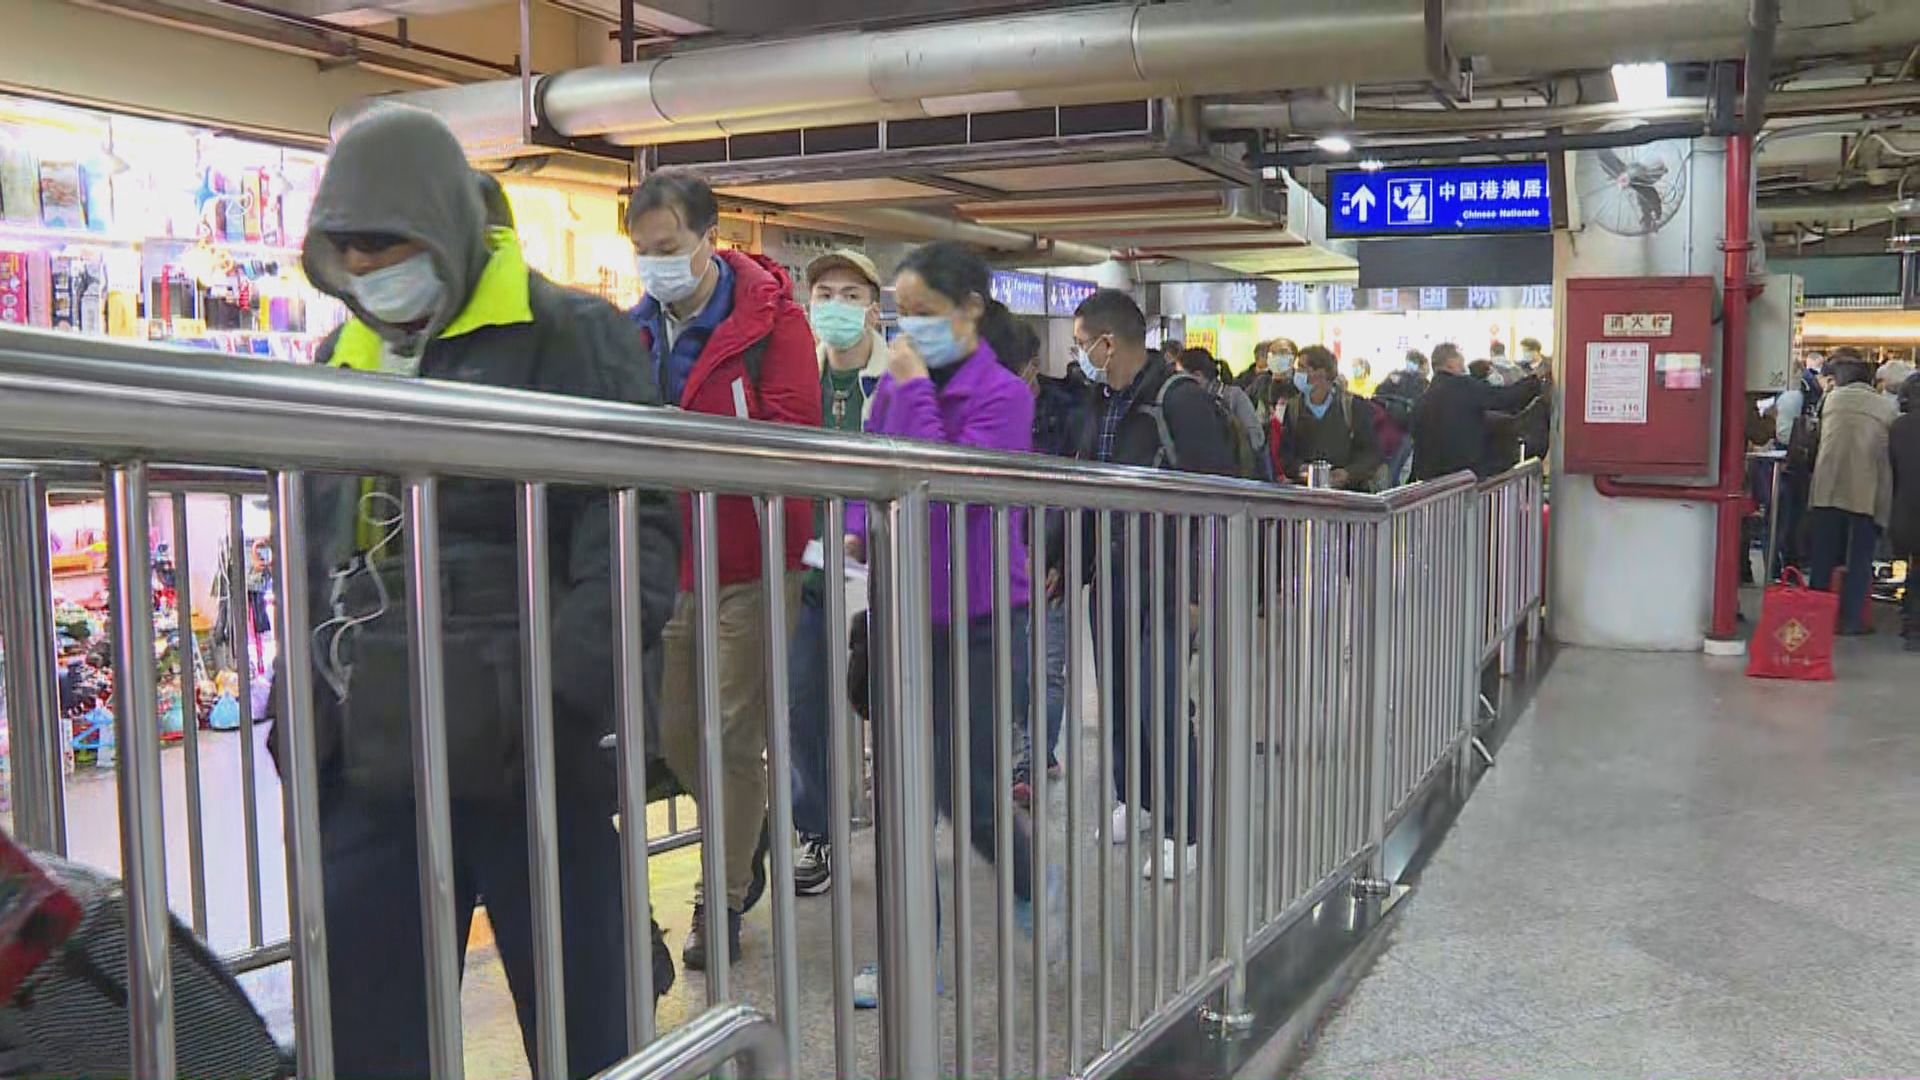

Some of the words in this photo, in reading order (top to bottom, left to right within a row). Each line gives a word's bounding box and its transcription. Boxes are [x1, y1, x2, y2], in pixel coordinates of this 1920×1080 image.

[1439, 179, 1551, 202] 中国港澳居
[1462, 209, 1497, 220] Chinese
[1499, 207, 1540, 218] Nationals
